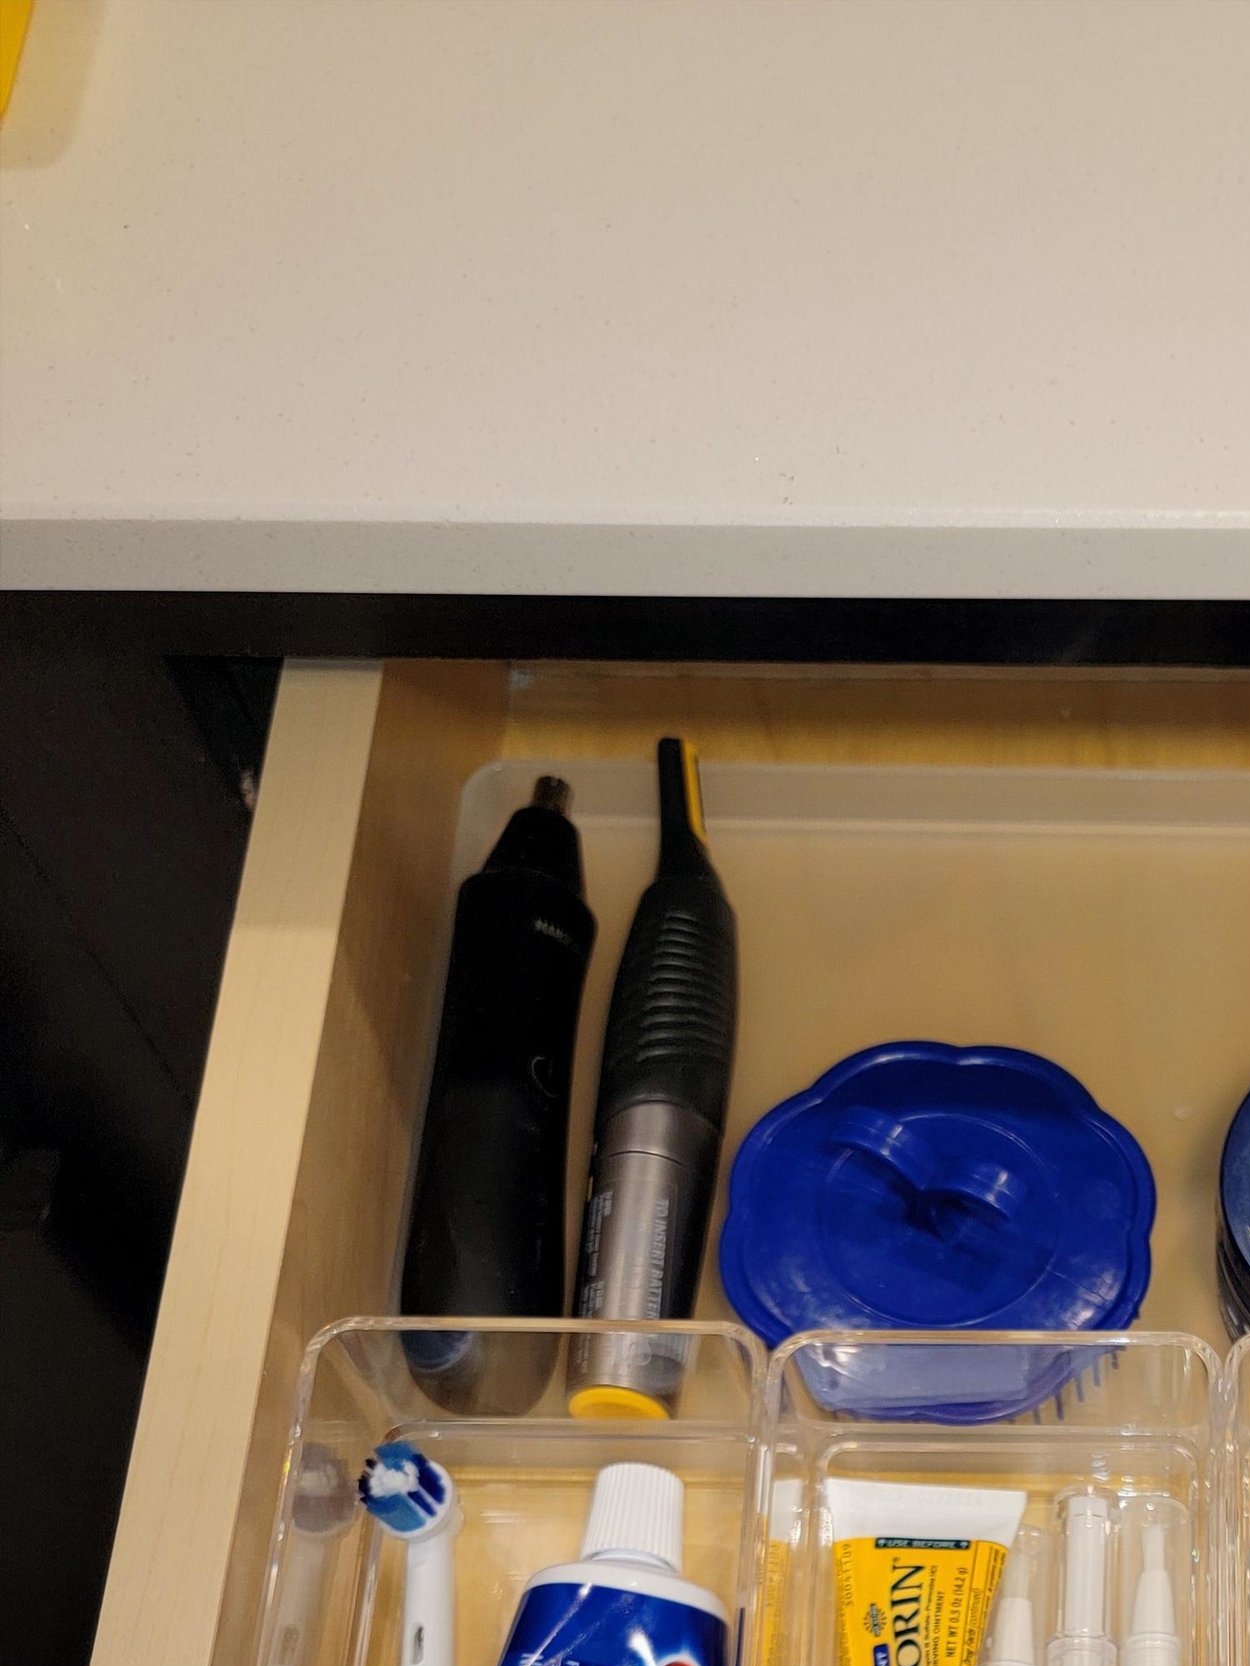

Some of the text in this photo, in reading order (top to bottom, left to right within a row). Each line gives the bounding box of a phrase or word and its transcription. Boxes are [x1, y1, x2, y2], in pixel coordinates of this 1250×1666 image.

[932, 1591, 945, 1635] OINTMENT
[946, 1625, 960, 1638] WT
[945, 1640, 958, 1658] NET
